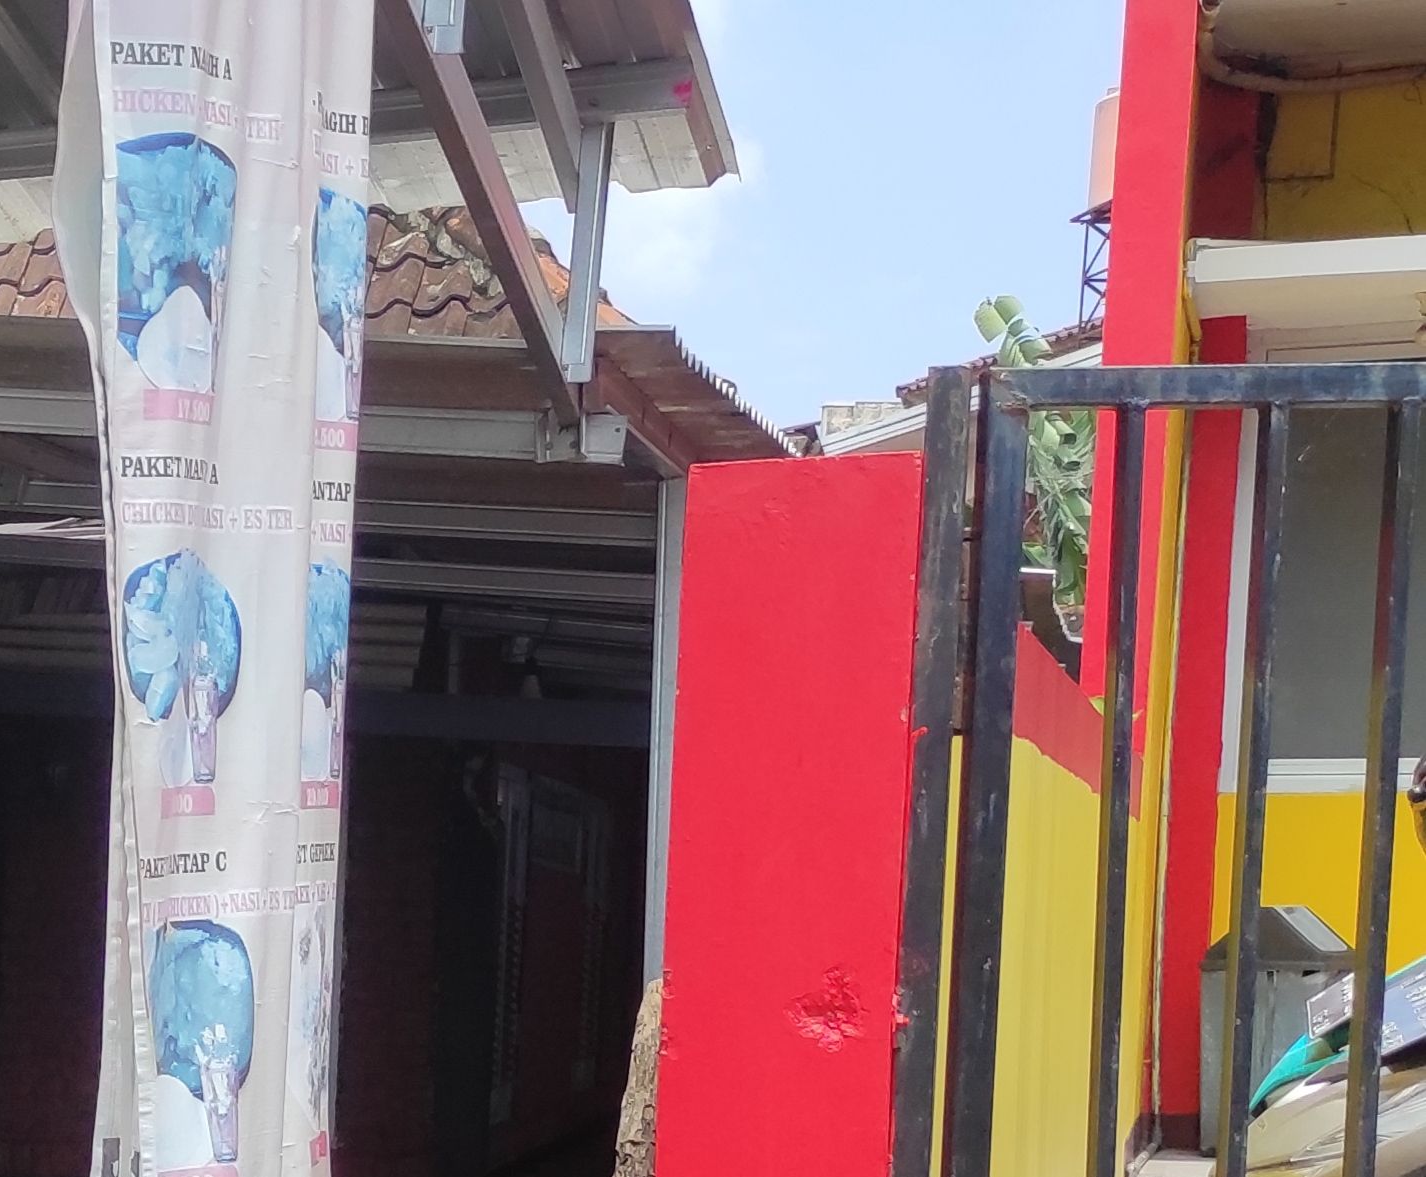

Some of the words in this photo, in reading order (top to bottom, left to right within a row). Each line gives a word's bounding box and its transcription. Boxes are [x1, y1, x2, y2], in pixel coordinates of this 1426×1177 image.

[110, 41, 185, 66] PAKET
[223, 58, 233, 80] A
[121, 456, 181, 478] PAKET
[210, 464, 219, 485] A
[215, 851, 227, 872] C
